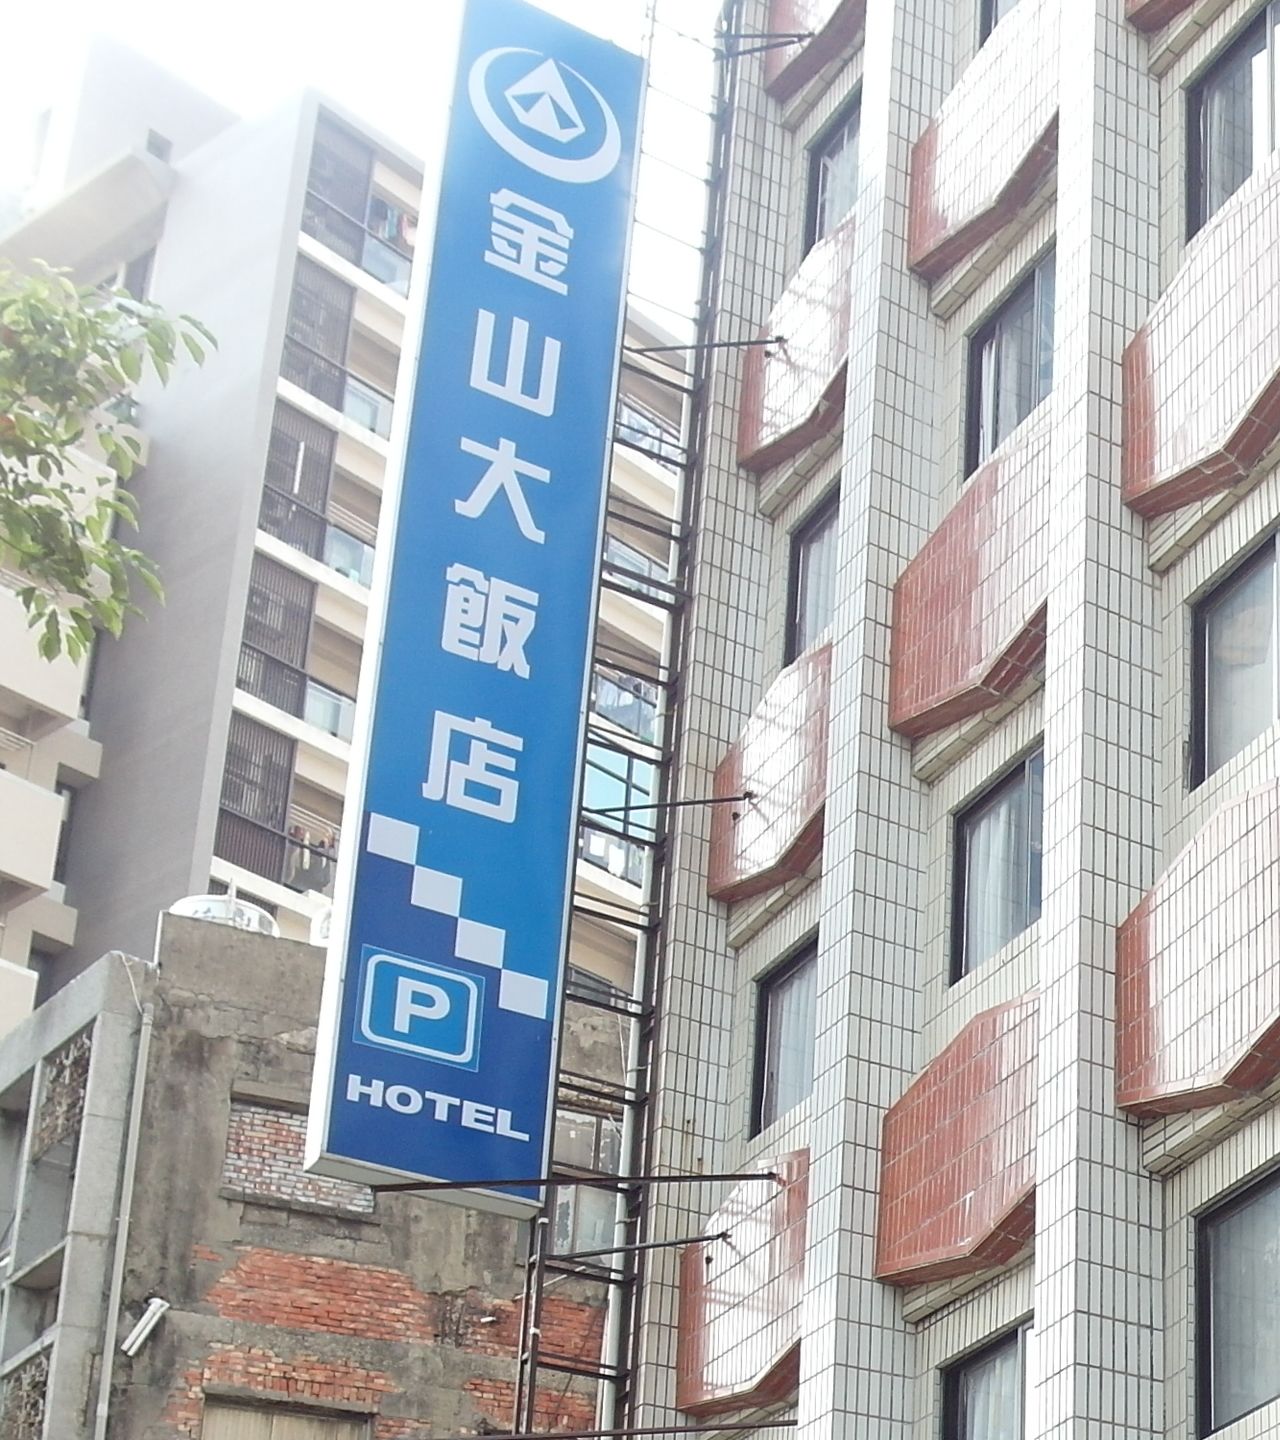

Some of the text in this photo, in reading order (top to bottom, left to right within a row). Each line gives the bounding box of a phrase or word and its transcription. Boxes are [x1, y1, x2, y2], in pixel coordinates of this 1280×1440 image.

[423, 188, 574, 823] 金山大飯店
[393, 976, 451, 1034] P
[346, 1074, 530, 1142] HOTEL
